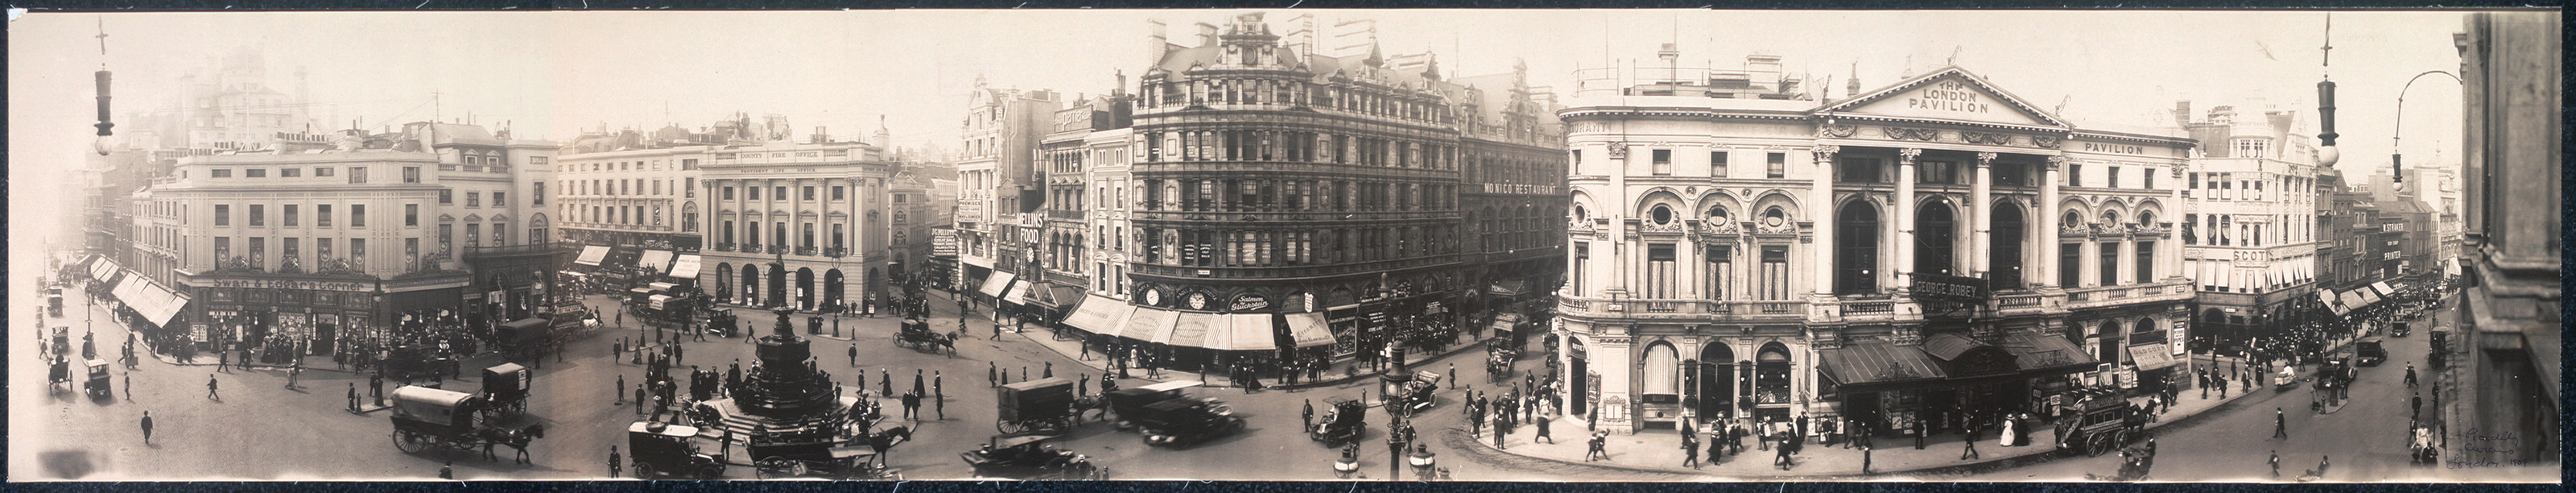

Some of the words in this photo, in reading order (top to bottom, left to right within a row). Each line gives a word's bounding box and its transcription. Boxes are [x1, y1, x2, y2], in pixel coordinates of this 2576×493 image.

[1923, 89, 1976, 102] LONDON
[1909, 98, 1988, 114] PAVILION
[2085, 143, 2143, 155] PAVILION
[1484, 183, 1512, 193] MONICO
[1516, 184, 1556, 195] RESTAURANT
[1017, 211, 1042, 227] MELLIN'S
[1020, 228, 1038, 243] FOOD
[2384, 251, 2401, 260] PRINTER
[214, 279, 250, 288] Swan
[254, 280, 264, 288] &
[268, 279, 316, 292] Edgar's
[319, 280, 364, 292] Corner
[1916, 280, 1946, 295] GEORGE
[1950, 284, 1977, 297] ROBEY
[2510, 458, 2528, 466] 1909
